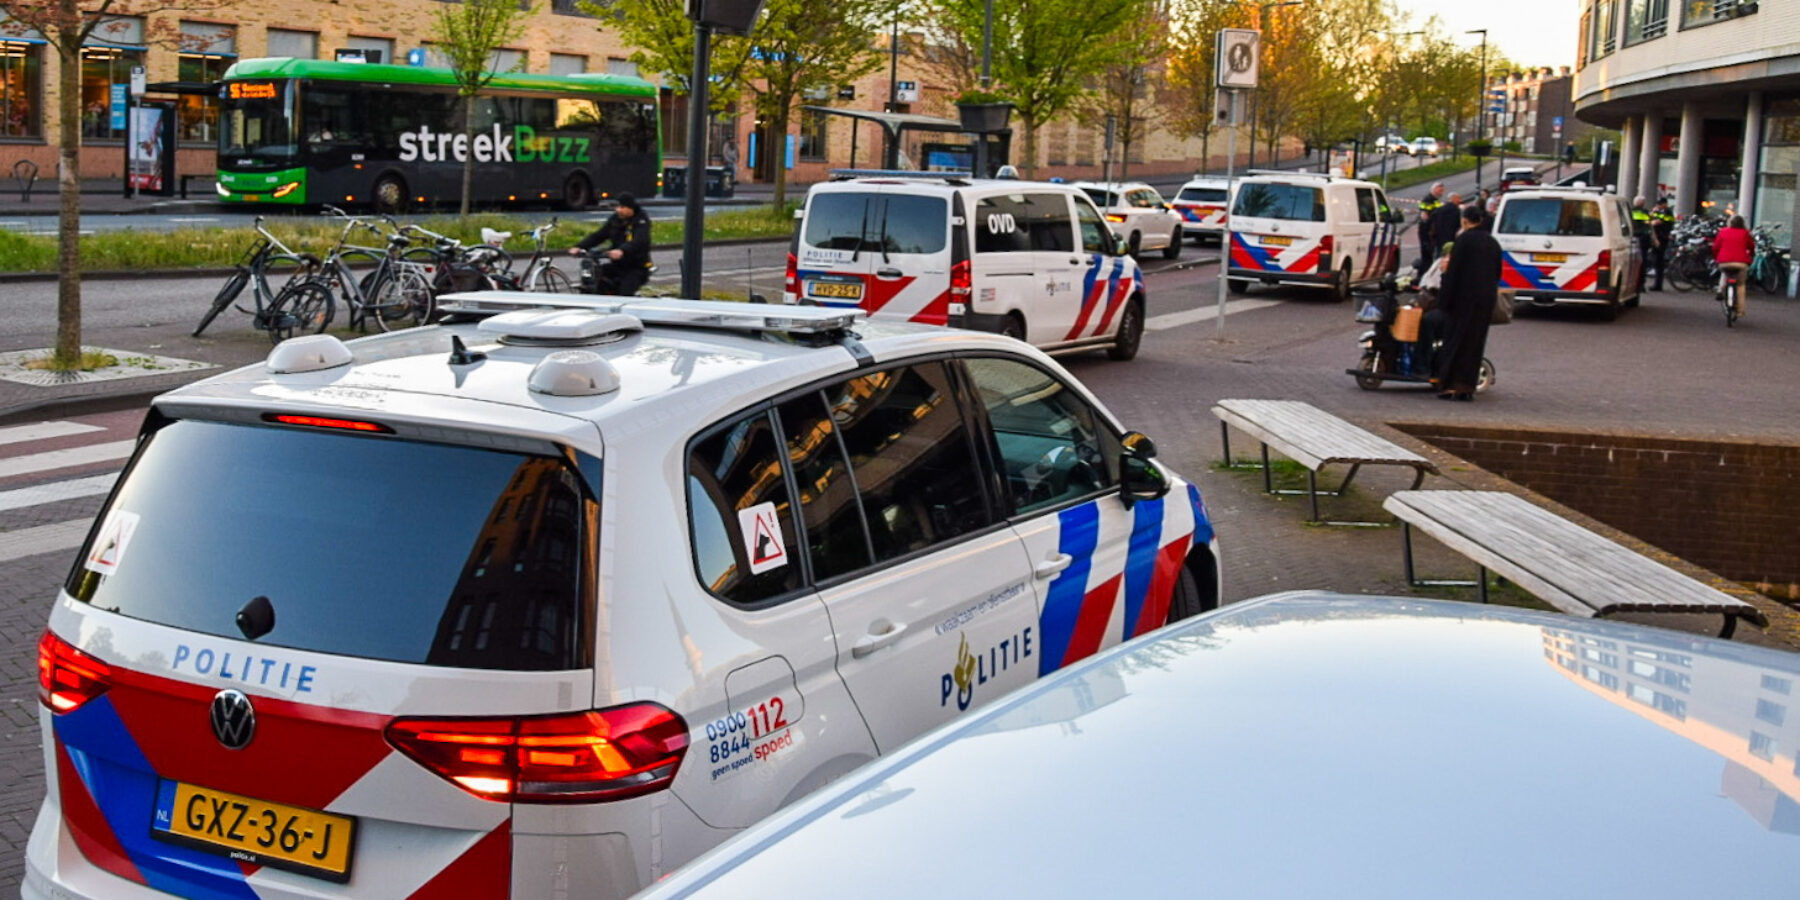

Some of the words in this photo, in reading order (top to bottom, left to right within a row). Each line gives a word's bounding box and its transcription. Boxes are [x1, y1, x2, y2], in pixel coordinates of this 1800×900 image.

[399, 123, 592, 163] streekBuzz
[988, 213, 1016, 235] OVD
[807, 250, 842, 259] POLITIE
[173, 645, 317, 693] POLITIE
[941, 627, 1032, 711] POLITIE
[706, 711, 746, 742] 0900
[747, 696, 787, 738] 112
[710, 731, 750, 764] 8844
[754, 728, 793, 762] spoed
[712, 764, 731, 781] geen
[731, 752, 754, 770] spoed
[156, 809, 169, 823] NL
[186, 794, 333, 860] GXZ-36-J
